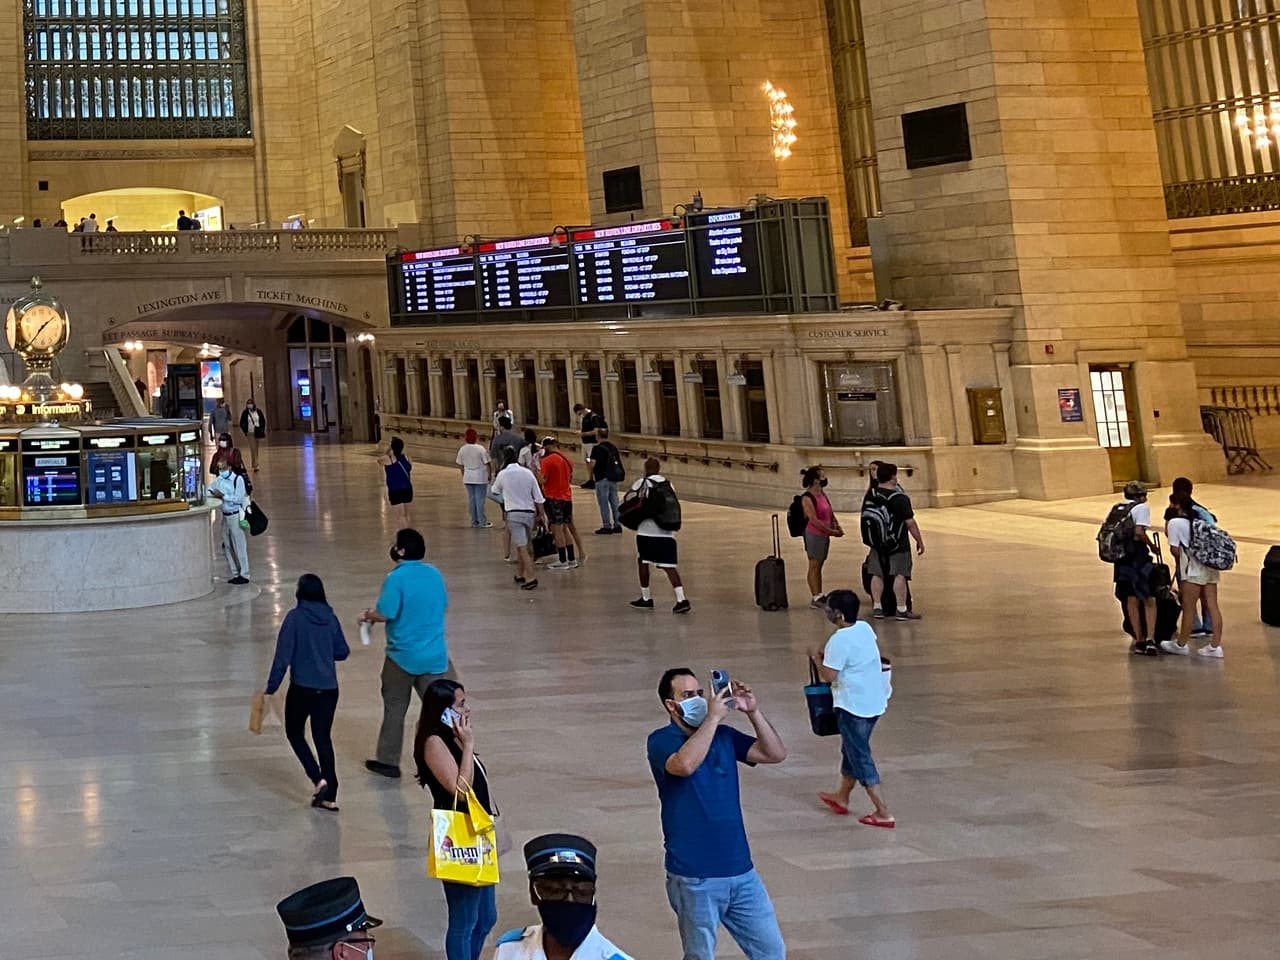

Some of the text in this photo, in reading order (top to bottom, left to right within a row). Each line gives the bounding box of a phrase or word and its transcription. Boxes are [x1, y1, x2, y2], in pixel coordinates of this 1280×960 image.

[137, 291, 221, 314] LEXINGTON AVE
[256, 290, 349, 312] TICKET MACHINES
[120, 329, 157, 340] PASSAGE
[161, 329, 199, 339] SUBWAY
[808, 329, 889, 338] CUSTOMER SERVICE
[32, 402, 80, 415] Information
